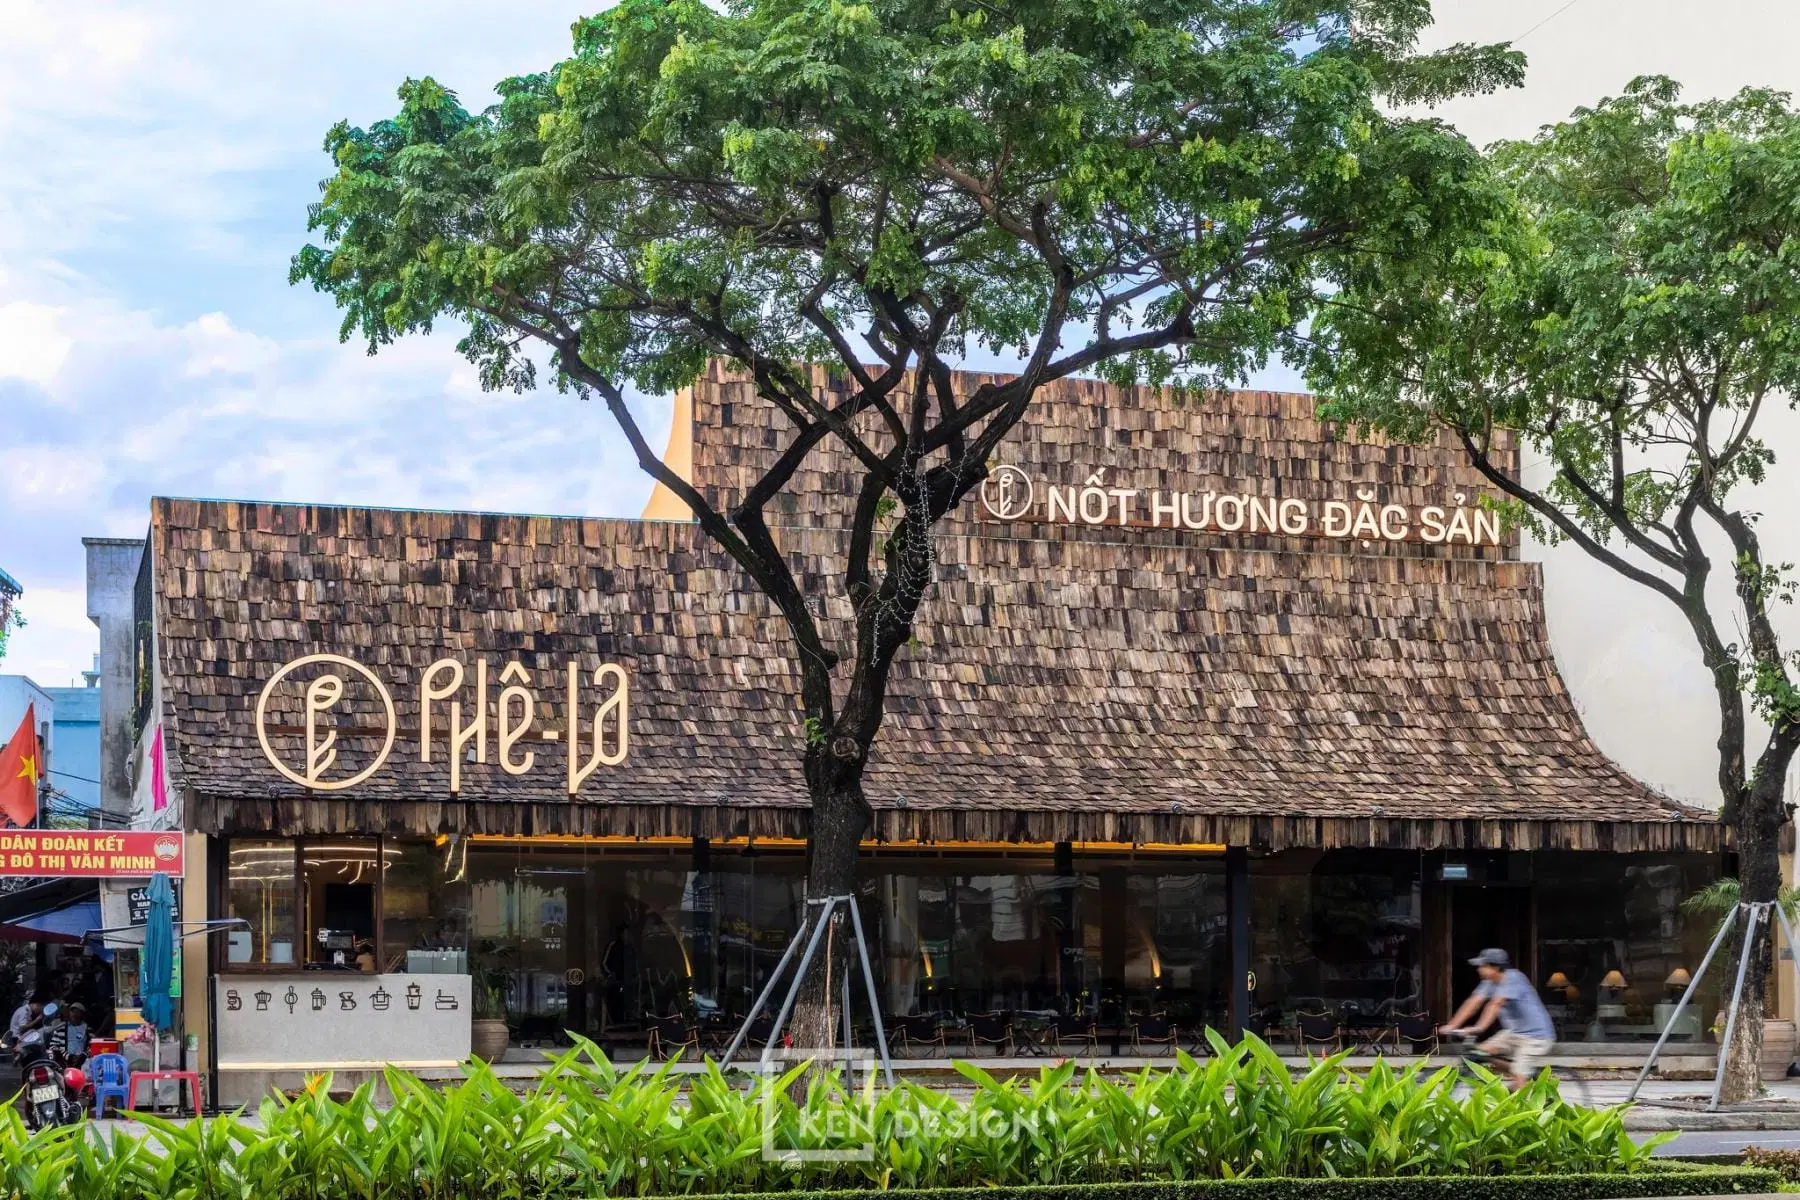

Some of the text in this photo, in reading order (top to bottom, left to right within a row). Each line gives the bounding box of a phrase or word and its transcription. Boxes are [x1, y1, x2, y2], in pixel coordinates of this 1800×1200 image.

[1048, 467, 1501, 548] NỐT HƯƠNG ĐẶC SẢN
[1, 835, 125, 851] DÂN ĐOÀN KẾT
[11, 852, 33, 868] ĐÔ
[39, 855, 65, 871] THỊ
[71, 853, 105, 869] VĂN
[110, 856, 155, 869] MINH
